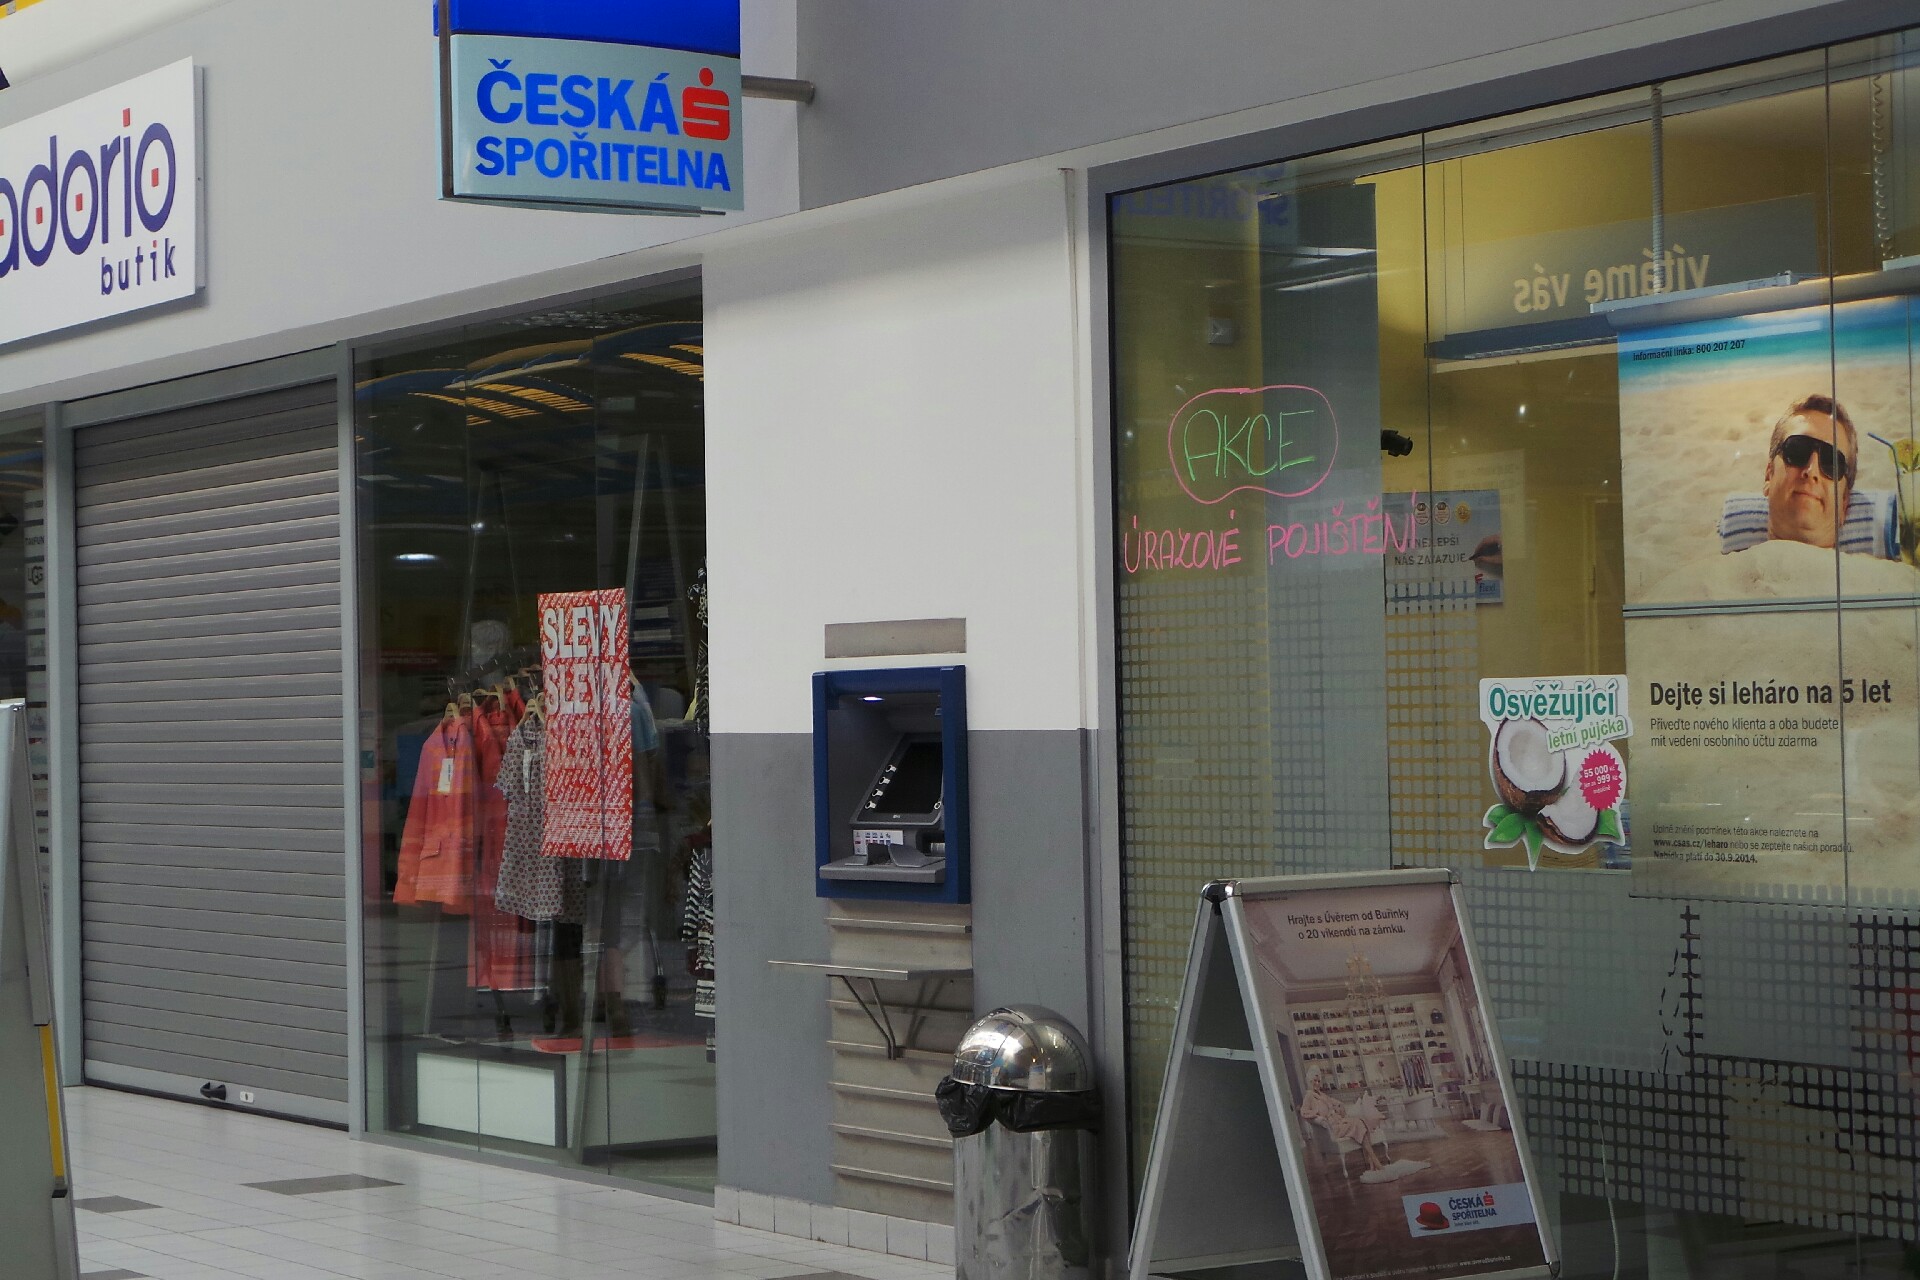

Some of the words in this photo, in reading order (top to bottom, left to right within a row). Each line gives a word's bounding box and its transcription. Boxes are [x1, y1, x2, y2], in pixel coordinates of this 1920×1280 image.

[476, 58, 680, 135] ČESKÁ
[475, 131, 731, 192] SPOŘITELNA
[101, 238, 176, 295] butik
[1696, 343, 1712, 354] 800
[1713, 341, 1728, 352] 207
[1730, 339, 1746, 350] 207
[1183, 409, 1316, 482] AKCE
[543, 604, 621, 660] SLEVY
[544, 661, 623, 716] SLEVY
[1650, 682, 1703, 710] Dejte
[1708, 681, 1726, 705] si
[1732, 679, 1799, 705] leháro
[1806, 684, 1833, 704] na
[1842, 679, 1855, 704] 5
[1862, 679, 1892, 704] let
[1489, 683, 1617, 724] Osvěžující
[1650, 717, 1691, 731] Přiveďte
[1693, 717, 1729, 731] nového
[1732, 716, 1766, 730] klienta
[1769, 720, 1776, 730] a
[1778, 716, 1799, 730] oba
[1801, 716, 1839, 730] budete
[1548, 727, 1578, 750] letní
[1581, 717, 1625, 745] půjčka
[1668, 734, 1701, 748] vedení
[1703, 734, 1750, 748] osobního
[1752, 734, 1775, 748] účtu
[1778, 735, 1818, 748] zdarma
[1583, 768, 1594, 778] 55
[1594, 764, 1609, 776] 000
[1596, 773, 1611, 785] 999
[1750, 842, 1760, 850] se
[1704, 852, 1714, 862] do
[1715, 852, 1759, 864] 30.9.2014.
[1287, 914, 1315, 927] Hrajte
[1317, 916, 1323, 924] s
[1324, 910, 1360, 924] Úvěrem
[1362, 910, 1374, 921] od
[1375, 907, 1409, 921] Buřinky
[1298, 931, 1305, 940] o
[1306, 929, 1319, 939] 20
[1320, 926, 1357, 939] víkendů
[1359, 927, 1371, 936] na
[1373, 924, 1406, 936] zámku.
[1448, 1193, 1484, 1211] ČESKÁ
[1452, 1208, 1498, 1221] SPOŘITELNA
